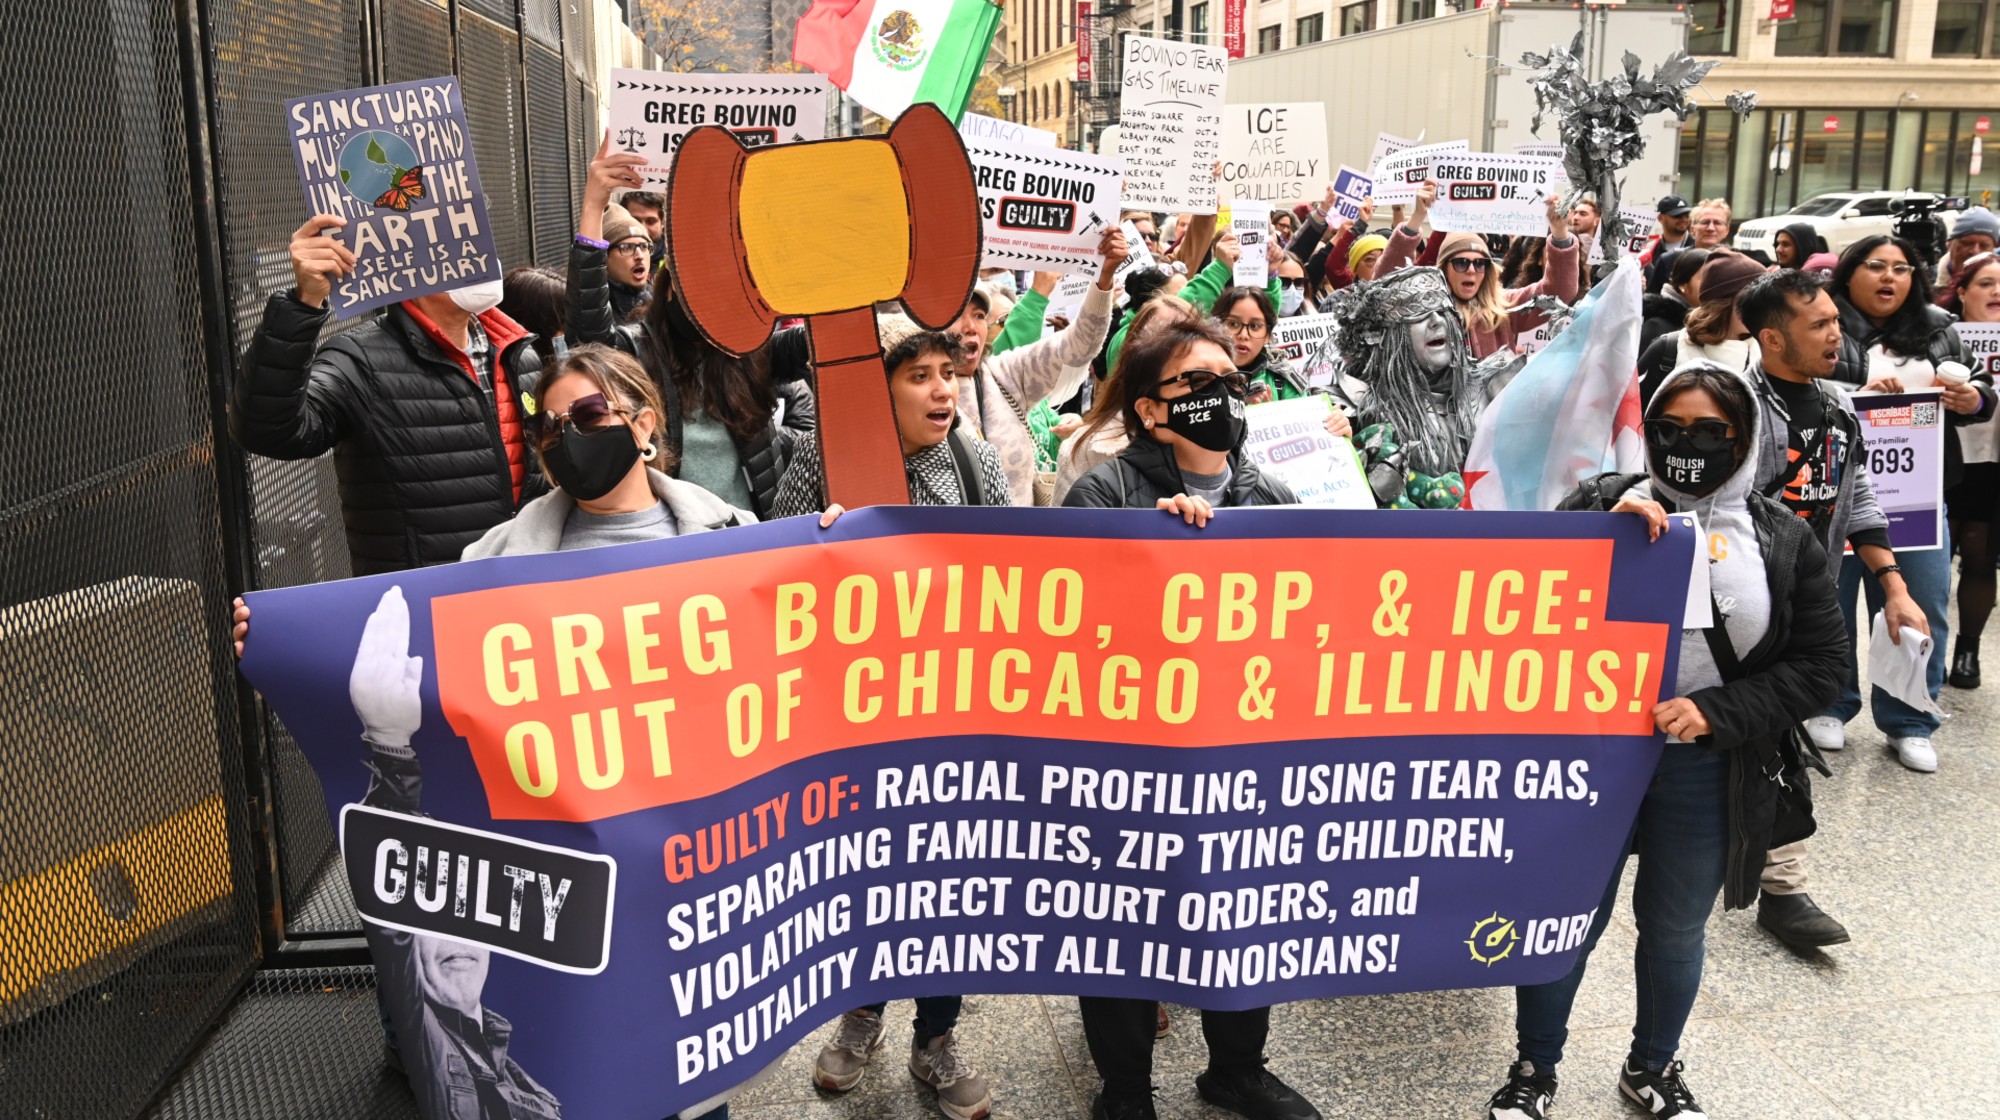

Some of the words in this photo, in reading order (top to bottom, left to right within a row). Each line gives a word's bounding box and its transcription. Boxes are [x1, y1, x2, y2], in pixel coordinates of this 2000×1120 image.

[1130, 39, 1188, 68] BOVINO
[1124, 69, 1154, 90] GAS
[1158, 70, 1220, 99] TIMELINE
[291, 82, 454, 137] SANCTUARY
[644, 100, 706, 125] GREG
[714, 103, 797, 127] BOVINO
[1122, 108, 1147, 118] LOGAN
[1151, 112, 1184, 121] SQUARE
[1214, 116, 1220, 124] 3
[1120, 121, 1156, 132] BRIGHTON
[1161, 124, 1184, 134] PARK
[1247, 108, 1288, 134] ICE
[298, 131, 347, 181] MUST
[393, 118, 464, 165] EXPAND
[1119, 132, 1149, 142] ALBANY
[1153, 136, 1175, 144] PARK
[1194, 140, 1211, 148] OCT
[1248, 137, 1285, 157] ARE
[1118, 145, 1141, 154] EAST
[1144, 147, 1162, 155] SIDE
[1193, 151, 1209, 159] OCT
[1146, 159, 1177, 168] VILLAGE
[1192, 162, 1208, 170] OCT
[1223, 159, 1319, 182] COWARDLY
[1386, 158, 1413, 171] GREG
[1437, 165, 1473, 181] GREG
[1477, 166, 1529, 184] BOVINO
[1533, 170, 1546, 184] IS
[1189, 174, 1207, 182] OCT
[1394, 172, 1404, 182] IS
[308, 180, 376, 222] UNTIL
[422, 160, 473, 205] THE
[1022, 172, 1096, 205] BOVINO
[1188, 186, 1205, 194] OCT
[1207, 187, 1217, 195] 25
[1234, 182, 1303, 201] BULLIES
[1345, 176, 1372, 200] ICE
[1453, 185, 1493, 198] GUILTY
[1501, 184, 1529, 201] OF...
[1133, 194, 1157, 203] IRVING
[1161, 195, 1180, 206] PARK
[1187, 199, 1204, 207] OCT
[1206, 199, 1217, 208] 25
[1005, 203, 1070, 228] GUILTY
[1234, 219, 1249, 229] GREG
[430, 243, 450, 262] IS
[461, 240, 478, 257] A
[339, 254, 490, 309] SANCTUARY
[1281, 326, 1324, 343] BOVINO
[1172, 397, 1223, 415] ABOLISH
[1871, 407, 1911, 418] INSCRÍBASE
[1188, 410, 1212, 424] ICE
[1878, 437, 1909, 445] Familiar
[1251, 451, 1266, 465] IS
[1271, 440, 1312, 461] GUILTY
[1666, 455, 1705, 470] ABOLISH
[1667, 467, 1702, 483] ICE
[482, 592, 734, 708] GREG
[775, 565, 1112, 656] BOVINO,
[1161, 571, 1331, 649] CBP,
[1371, 569, 1412, 638] &
[1451, 569, 1593, 637] ICE:
[504, 698, 677, 799] OUT
[725, 667, 803, 759] OF
[842, 647, 1201, 725] CHICAGO
[1237, 655, 1277, 722] &
[1314, 649, 1651, 717] ILLINOIS!
[663, 792, 790, 885] GUILTY
[802, 775, 861, 827] OF:
[875, 759, 1026, 810] RACIAL
[1041, 764, 1268, 816] PROFILING,
[1281, 761, 1397, 808] USING
[1409, 759, 1502, 801] TEAR
[1513, 759, 1600, 807] GAS,
[374, 838, 573, 942] GUILTY
[666, 828, 892, 952] SEPARATING
[907, 819, 1103, 871] FAMILIES,
[1116, 829, 1184, 872] ZIP
[1198, 824, 1304, 875] TYING
[1316, 817, 1515, 864] CHILDREN,
[1522, 905, 1599, 956] ICIR
[670, 893, 852, 1019] VIOLATING
[866, 876, 1013, 927] DIRECT
[1025, 877, 1166, 925] COURT
[1178, 880, 1338, 933] ORDERS,
[1350, 876, 1420, 917] and
[676, 947, 859, 1086] BRUTALITY
[869, 933, 1045, 982] AGAINST
[1055, 935, 1126, 976] ALL
[1140, 934, 1401, 989] ILLINOISIANS!
